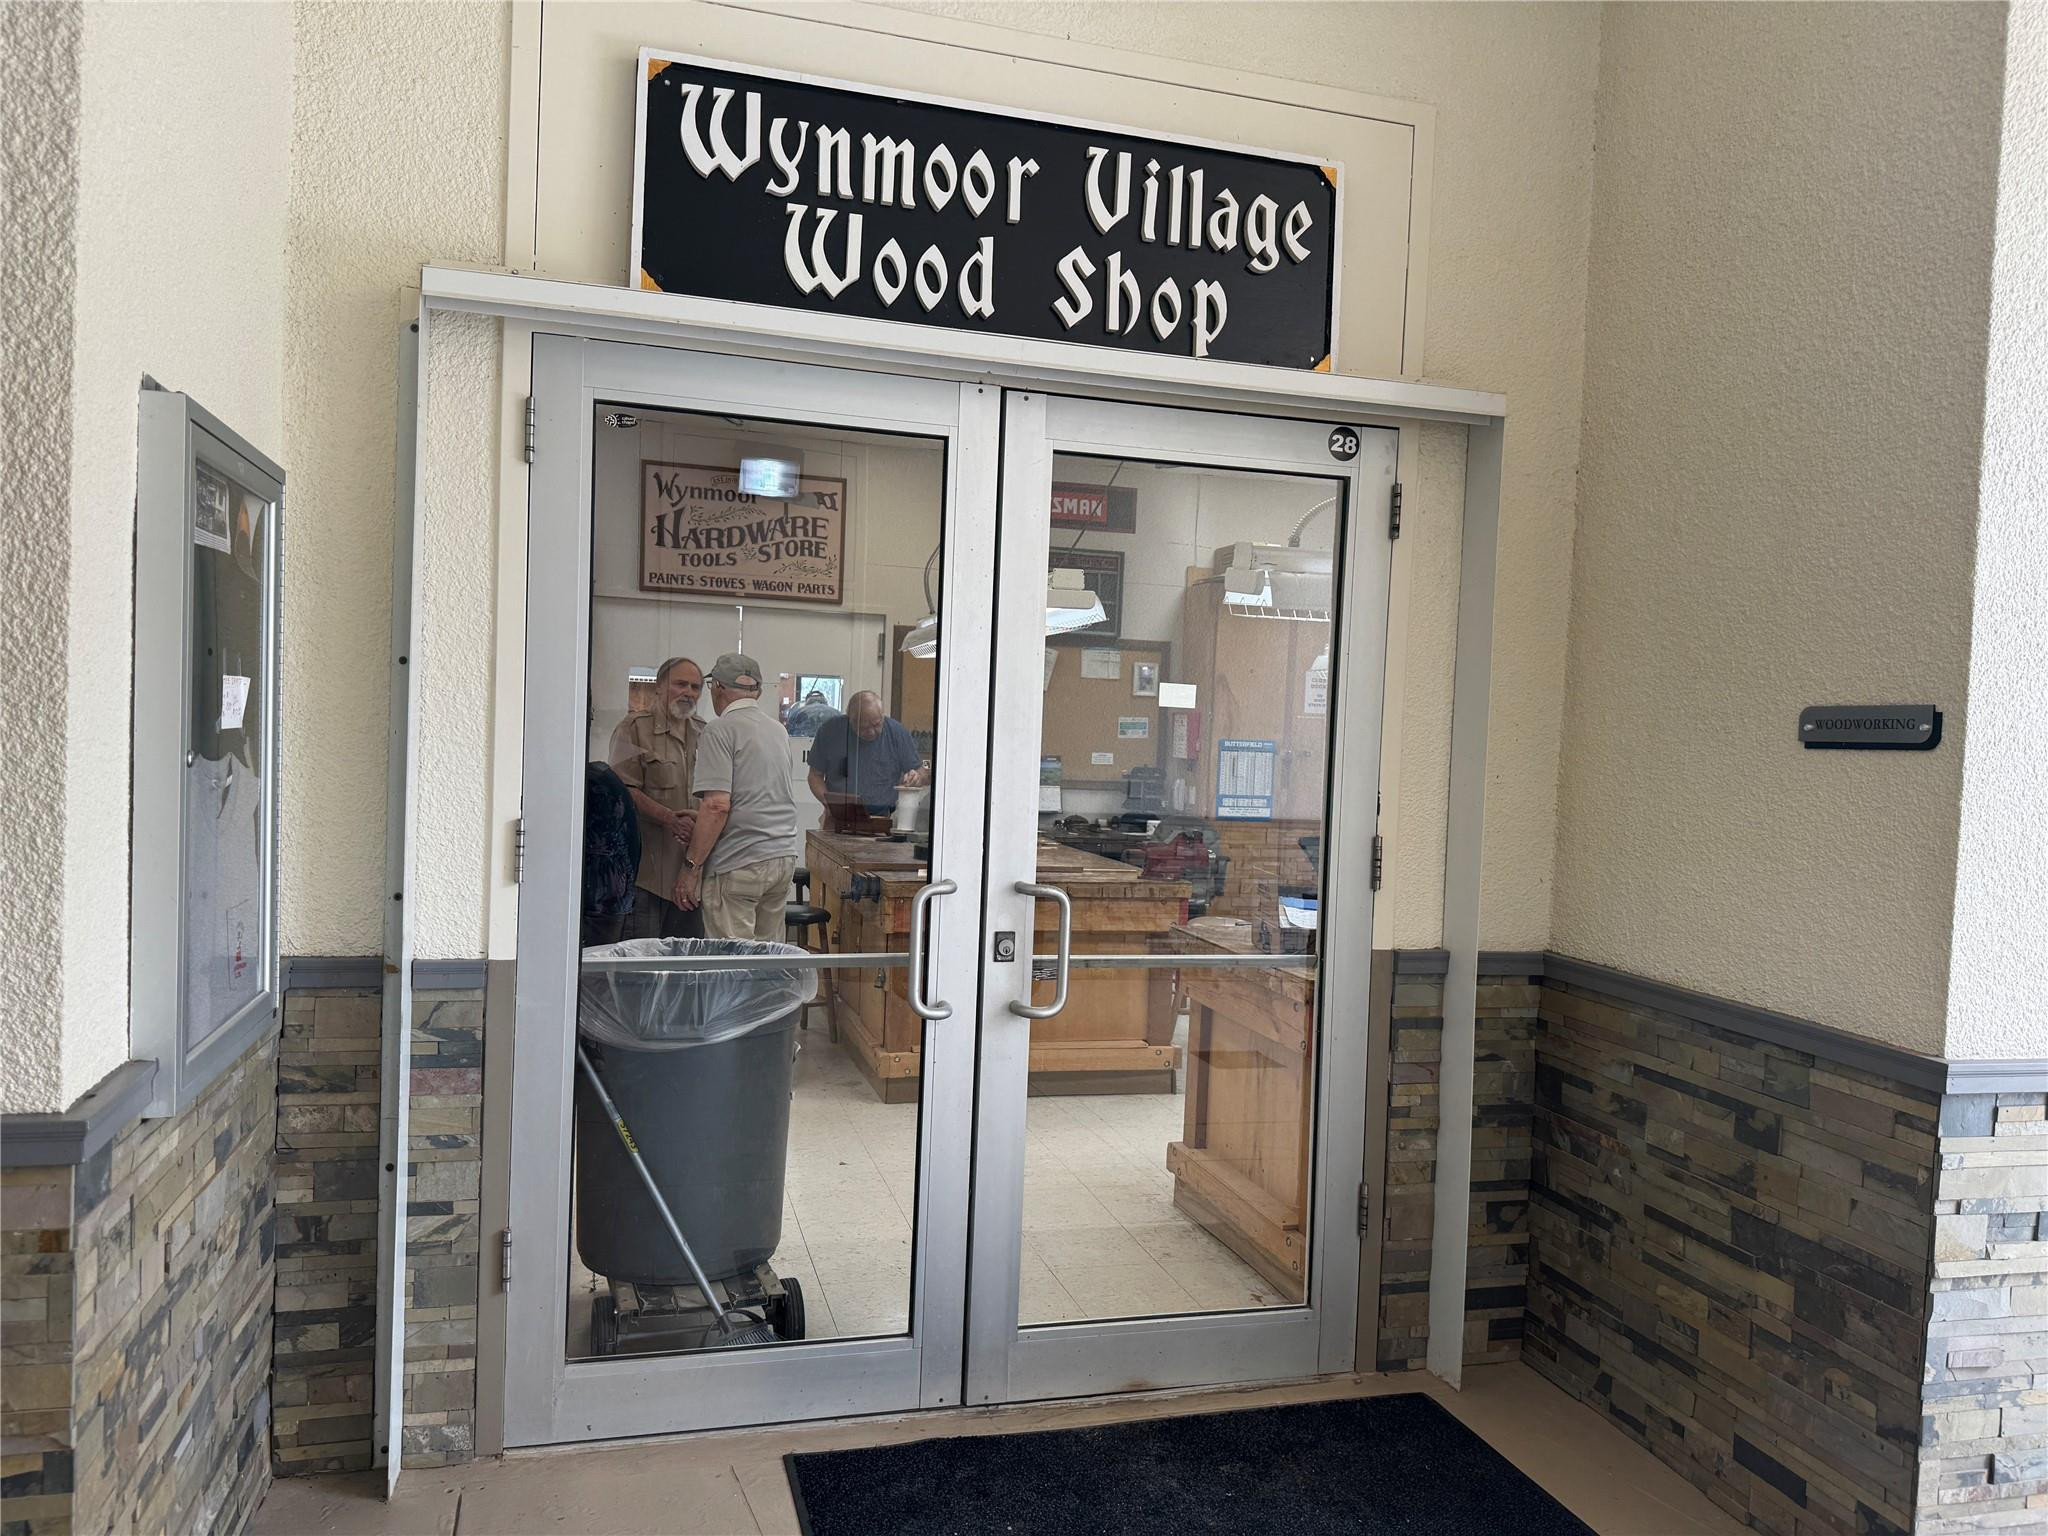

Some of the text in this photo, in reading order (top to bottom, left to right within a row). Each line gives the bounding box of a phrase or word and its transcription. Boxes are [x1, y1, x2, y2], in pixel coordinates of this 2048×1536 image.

[681, 83, 1313, 274] Wynmoor Village
[784, 202, 1227, 357] Wood Shop
[1331, 434, 1357, 454] 28
[649, 507, 829, 549] HARDWARE
[678, 552, 737, 568] TOOLS
[758, 540, 828, 563] STORE
[648, 572, 835, 596] PAINTS STOVES WAGON PARTS
[1815, 718, 1916, 730] WOODWORKING
